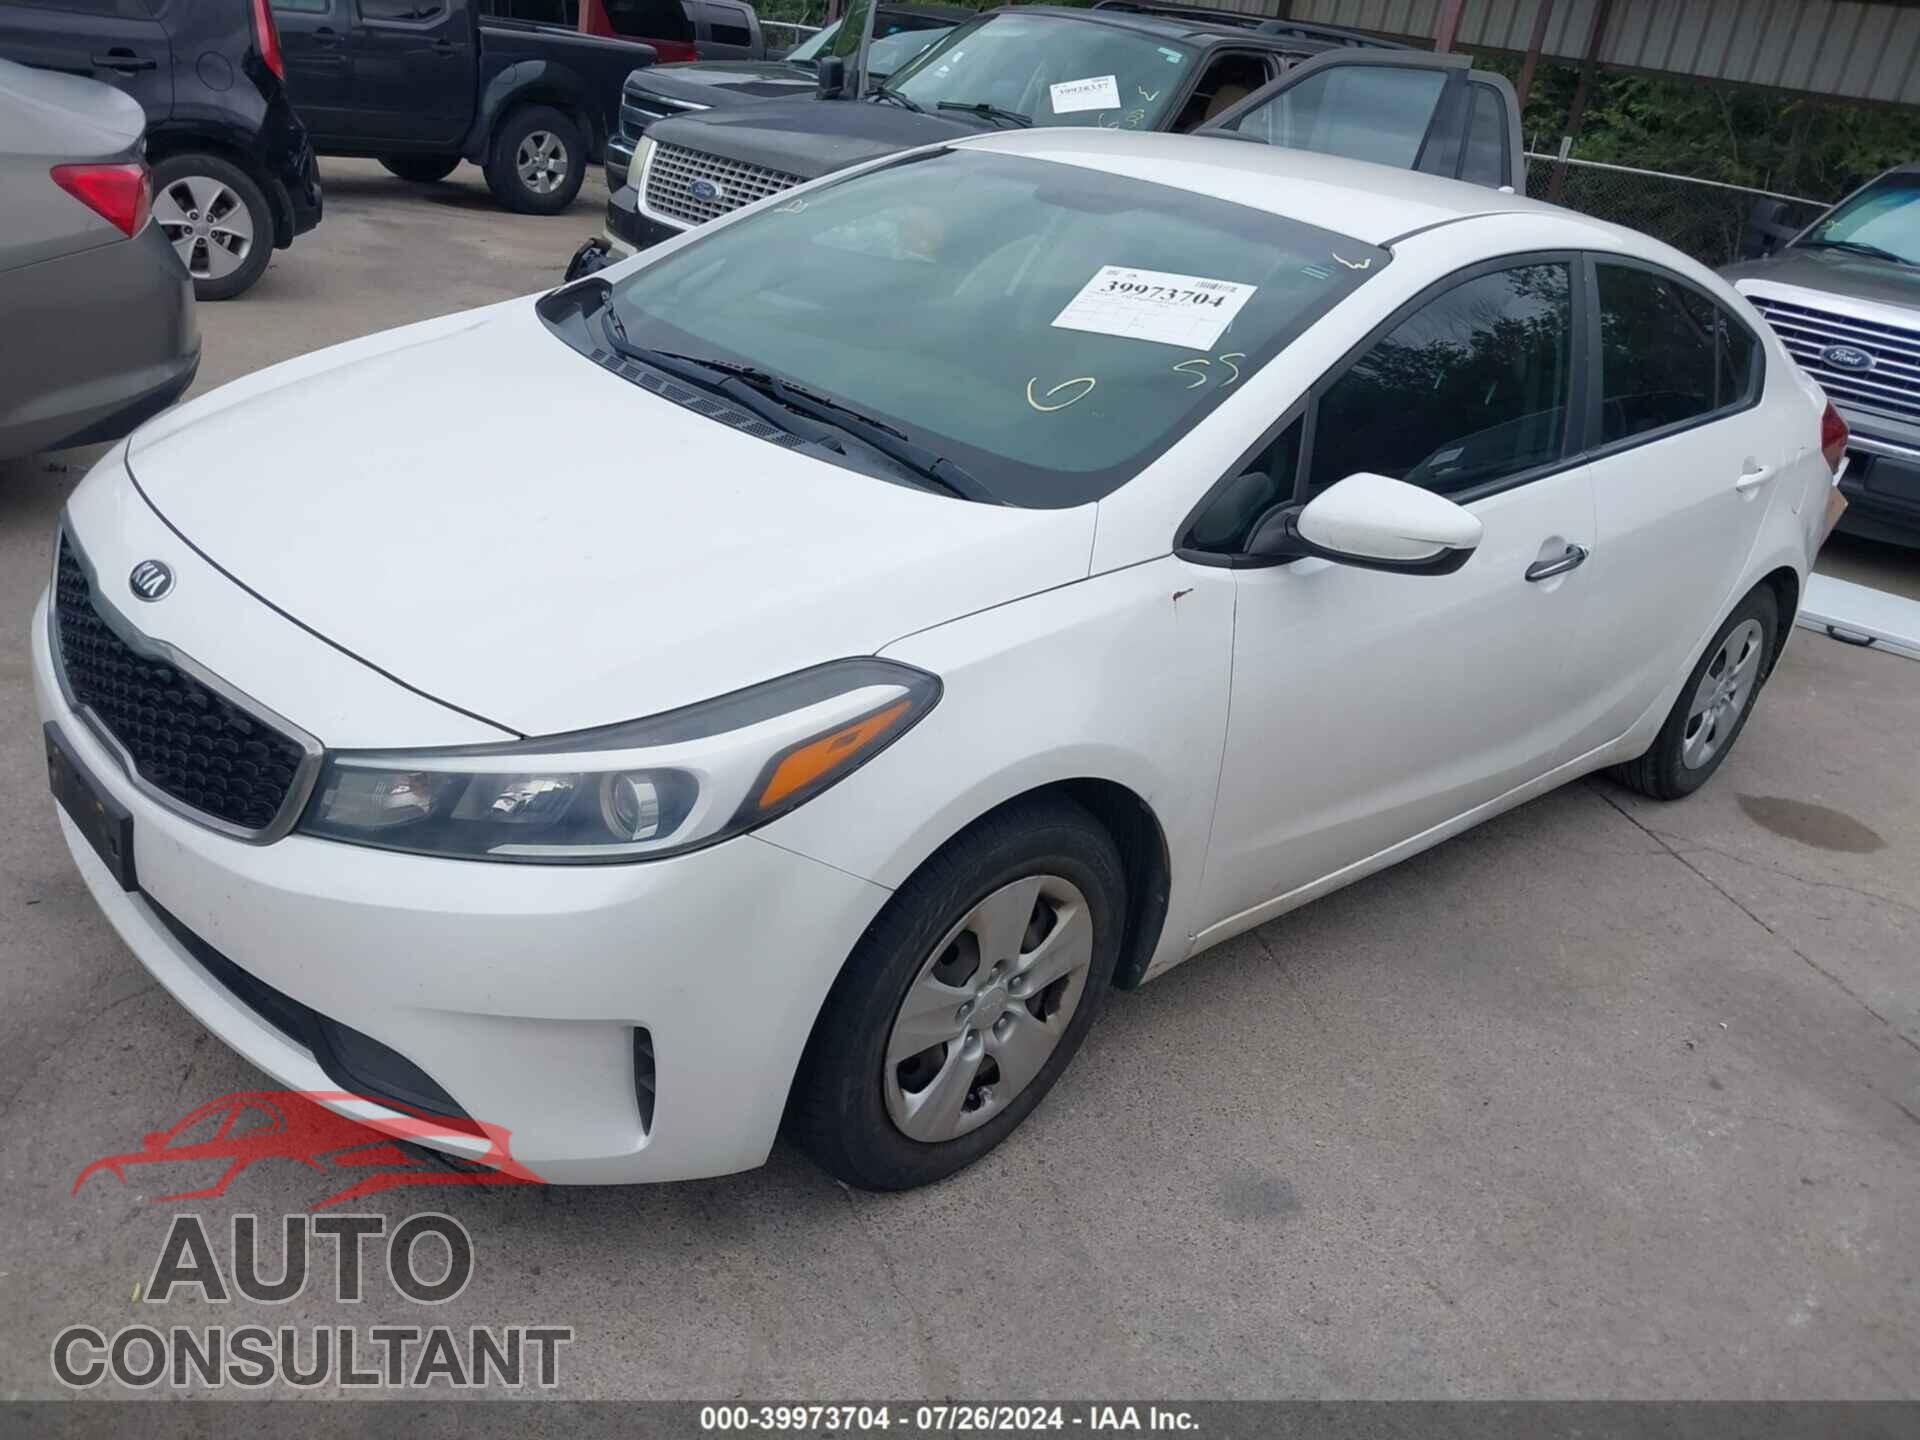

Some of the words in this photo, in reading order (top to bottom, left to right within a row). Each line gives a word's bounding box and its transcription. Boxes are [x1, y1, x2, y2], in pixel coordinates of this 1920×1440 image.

[1100, 280, 1226, 308] 39973704
[1829, 349, 1863, 365] Ford
[1027, 376, 1096, 411] 6
